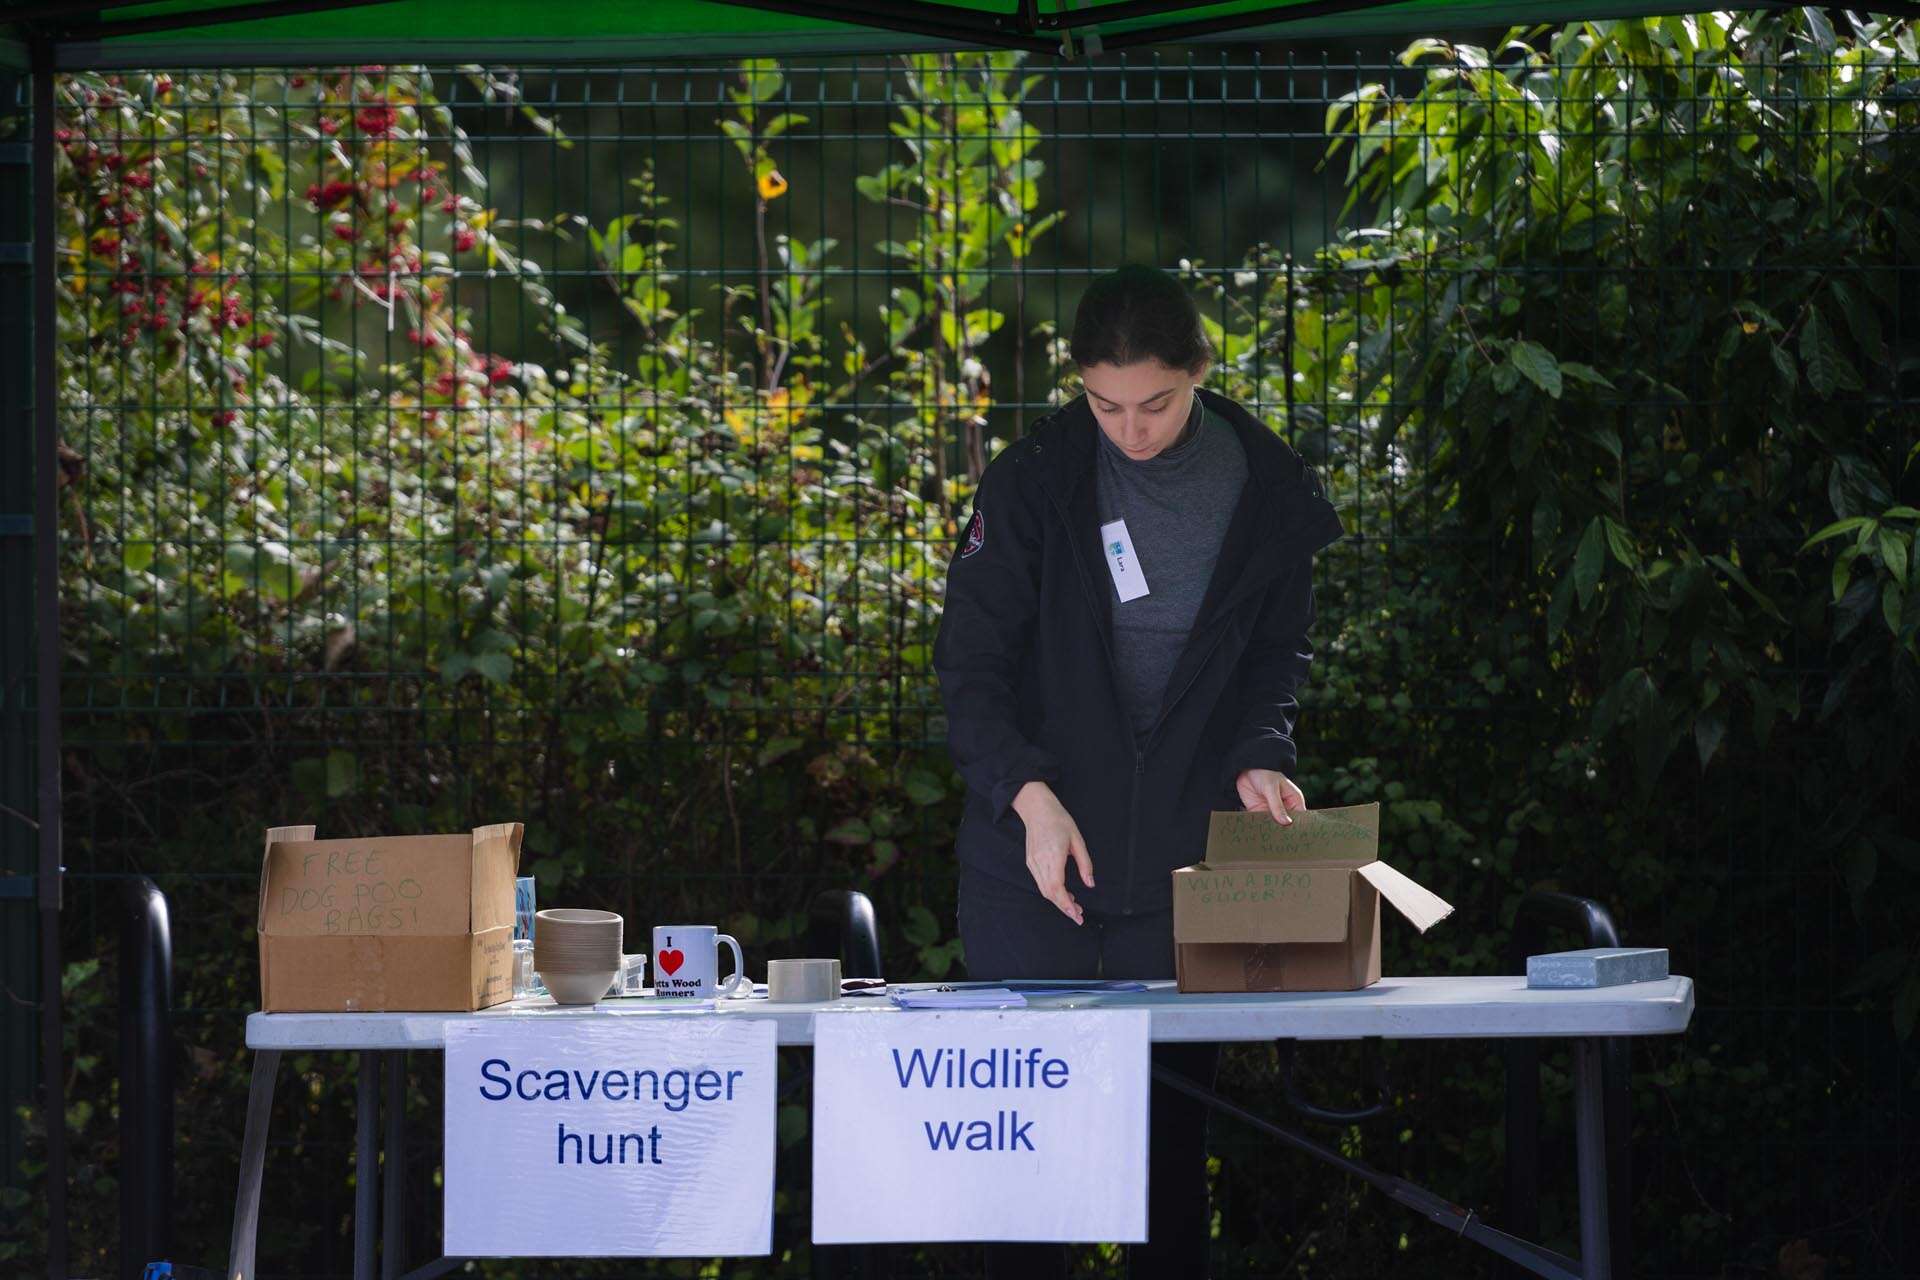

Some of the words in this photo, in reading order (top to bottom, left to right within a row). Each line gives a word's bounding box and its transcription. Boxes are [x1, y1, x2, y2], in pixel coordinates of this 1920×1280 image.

[303, 850, 390, 876] FREE
[280, 884, 336, 916] DOG
[352, 878, 424, 906] POO
[1188, 873, 1233, 892] WIN
[1246, 872, 1256, 888] A
[1264, 871, 1312, 889] BIRD
[323, 905, 418, 933] BAGS!
[666, 936, 673, 948] I
[672, 979, 702, 988] Wood
[893, 1048, 1069, 1088] Wildlife
[480, 1059, 743, 1111] Scavenger
[558, 1123, 662, 1164] hunt
[925, 1111, 1034, 1151] walk
